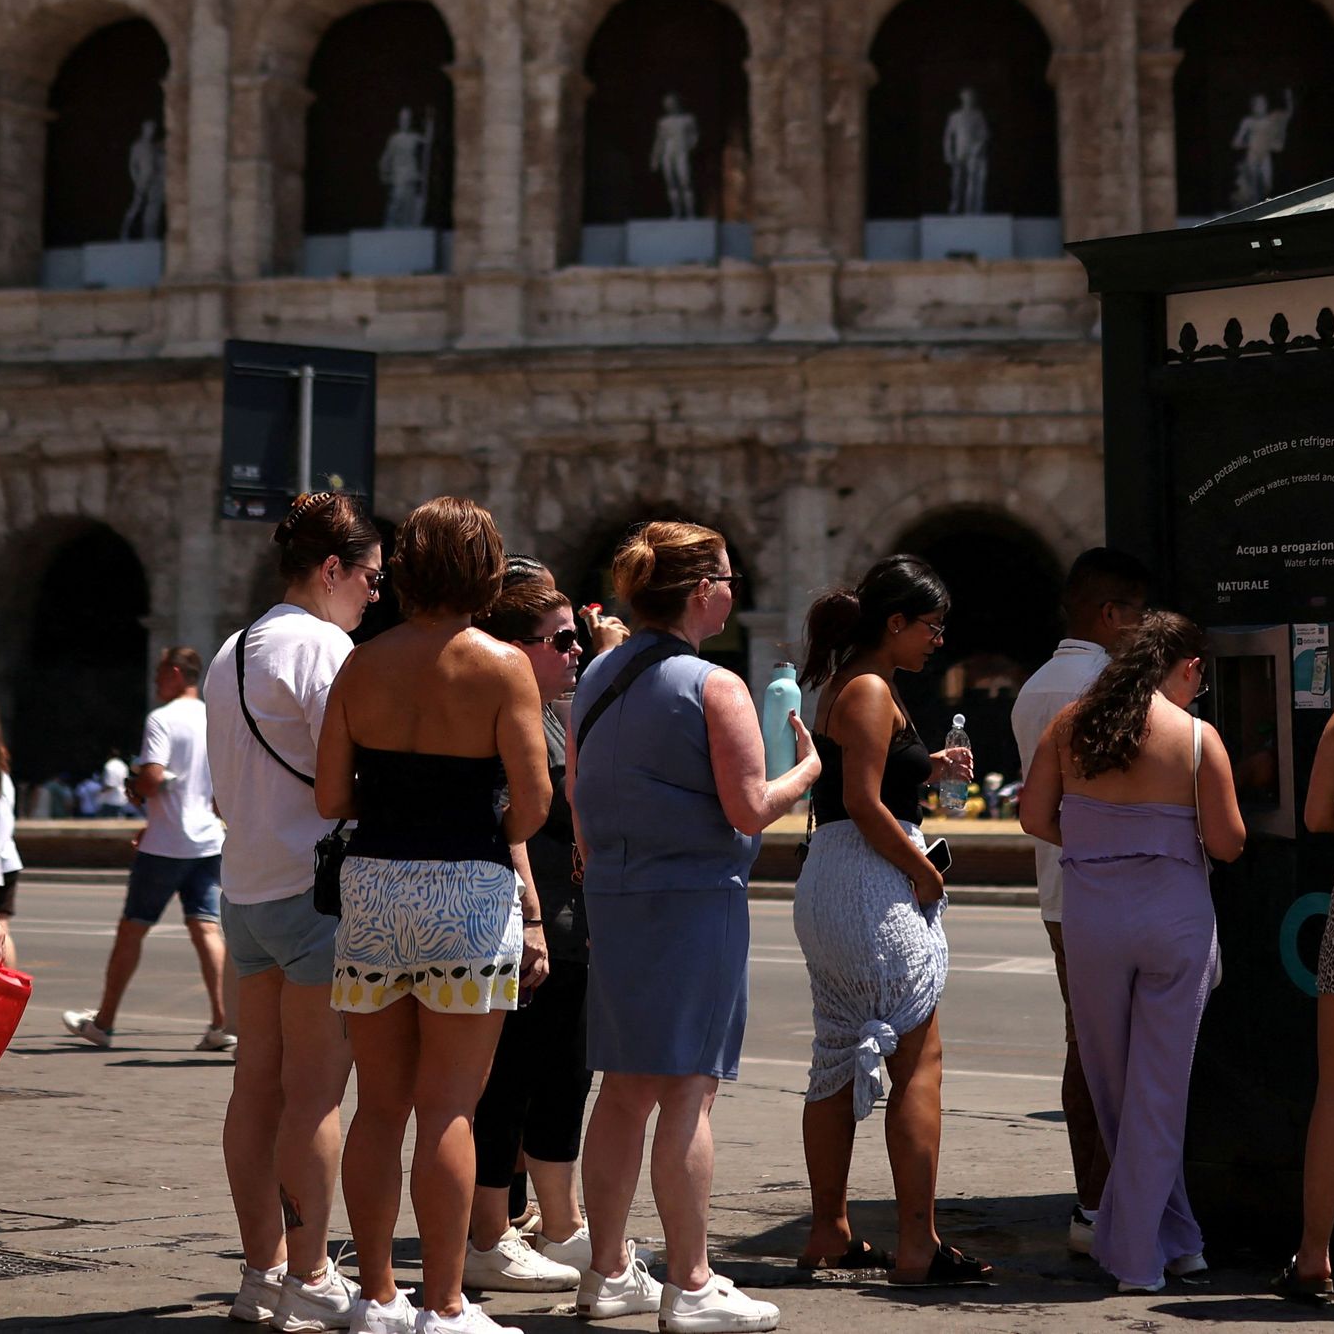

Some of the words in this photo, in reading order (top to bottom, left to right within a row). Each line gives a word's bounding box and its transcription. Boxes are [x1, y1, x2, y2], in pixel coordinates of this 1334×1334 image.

[1188, 479, 1213, 504] Acqua
[1214, 454, 1252, 483] potabile,
[1252, 441, 1288, 458] trattata
[1291, 440, 1297, 448] e
[1234, 485, 1266, 507] Drinking
[1266, 477, 1291, 491] water,
[1291, 472, 1321, 484] treated
[1236, 544, 1268, 557] Acqua
[1284, 558, 1307, 568] Water
[1309, 557, 1320, 567] for
[1217, 579, 1270, 592] NATURALE
